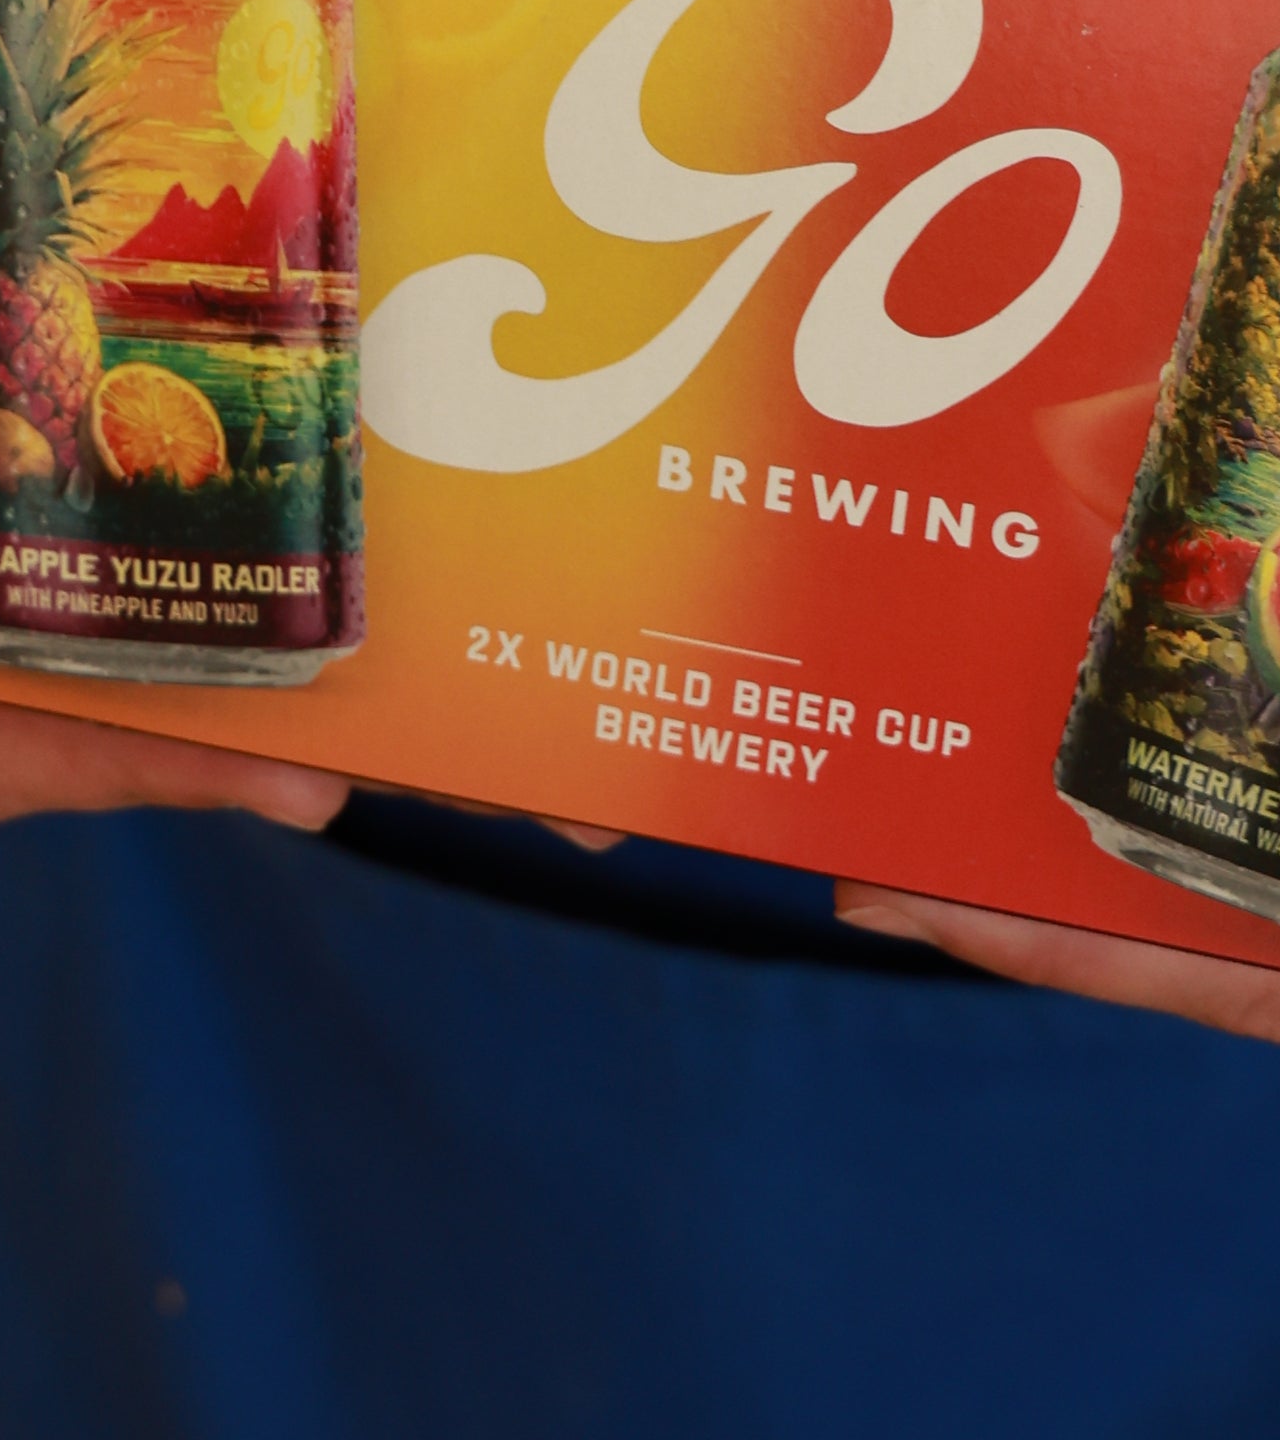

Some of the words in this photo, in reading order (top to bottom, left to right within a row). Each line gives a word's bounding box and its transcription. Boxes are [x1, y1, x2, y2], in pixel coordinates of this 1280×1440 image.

[656, 443, 1041, 559] BREWING
[7, 585, 53, 611] WITH
[55, 590, 164, 622] PINEAPPLE
[169, 600, 207, 624] AND
[212, 602, 259, 625] YUZU
[110, 555, 201, 591] YUZU
[212, 563, 320, 596] RADLER
[465, 625, 523, 669] 2X
[545, 639, 712, 709] WORLD
[732, 679, 855, 737] BEER
[875, 707, 972, 757] CUP
[594, 703, 829, 783] BREWERY
[1127, 777, 1168, 815] WITH
[1169, 786, 1249, 844] NATURAL
